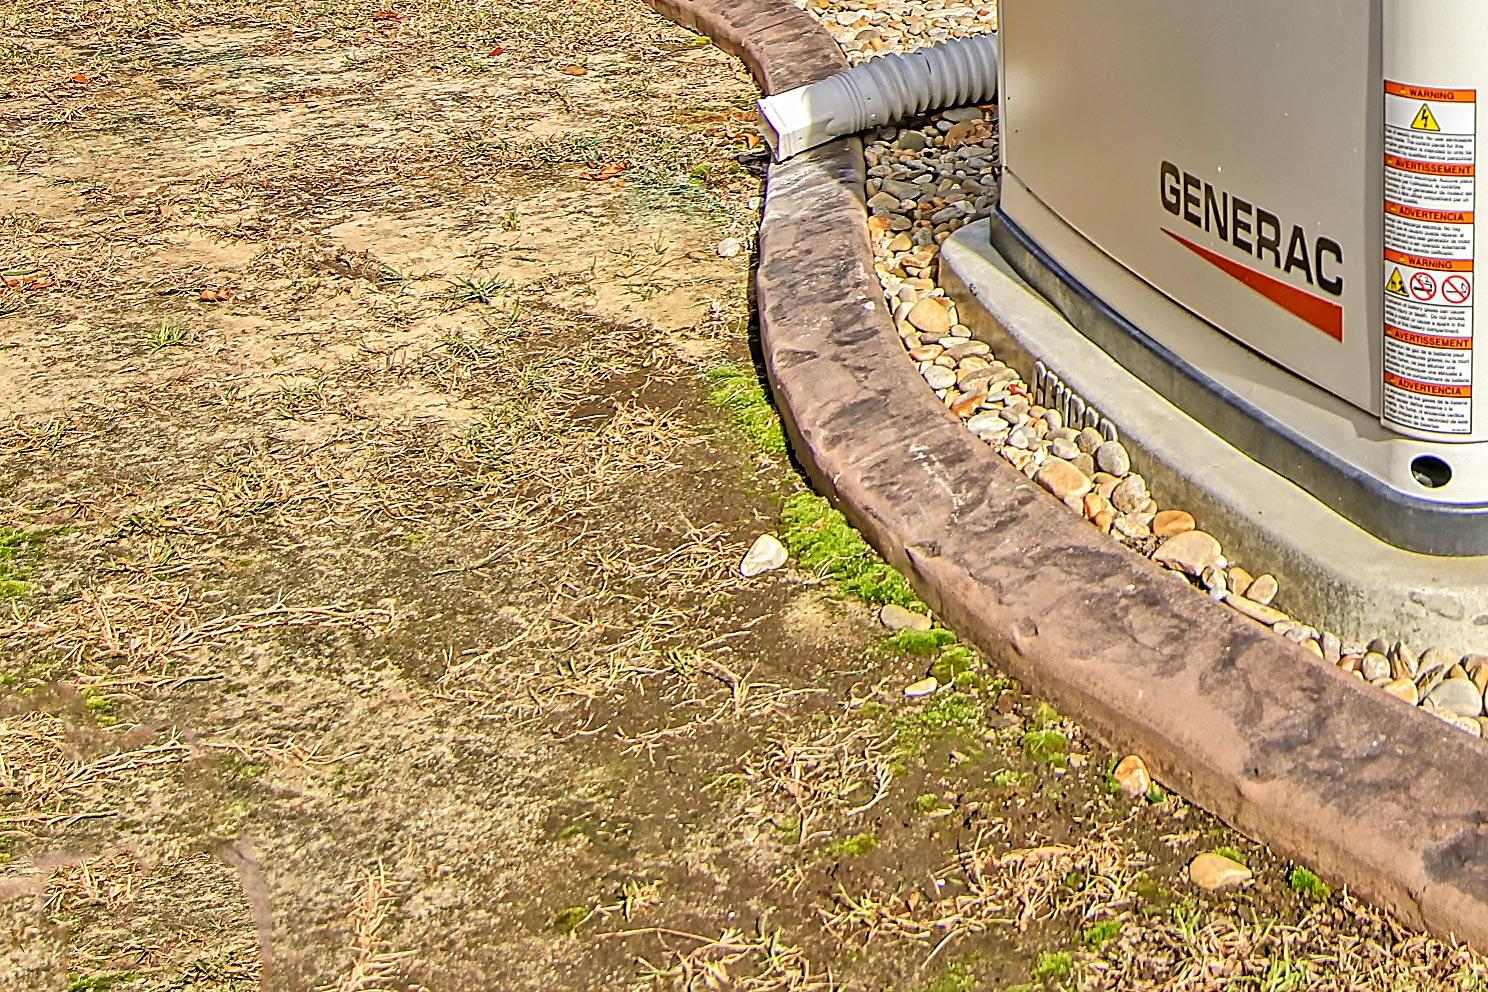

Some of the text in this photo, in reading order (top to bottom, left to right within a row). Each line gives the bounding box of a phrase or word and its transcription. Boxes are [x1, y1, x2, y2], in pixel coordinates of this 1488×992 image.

[1409, 89, 1454, 100] WARNING
[1396, 159, 1471, 174] AVERTISSEMENT
[1399, 206, 1464, 221] ADVERTENCIA
[1160, 160, 1344, 296] GENERAC
[1408, 256, 1452, 269] WARNING
[1395, 331, 1469, 347] AVERTISSEMENT
[1398, 379, 1461, 395] ADVERTENCIA
